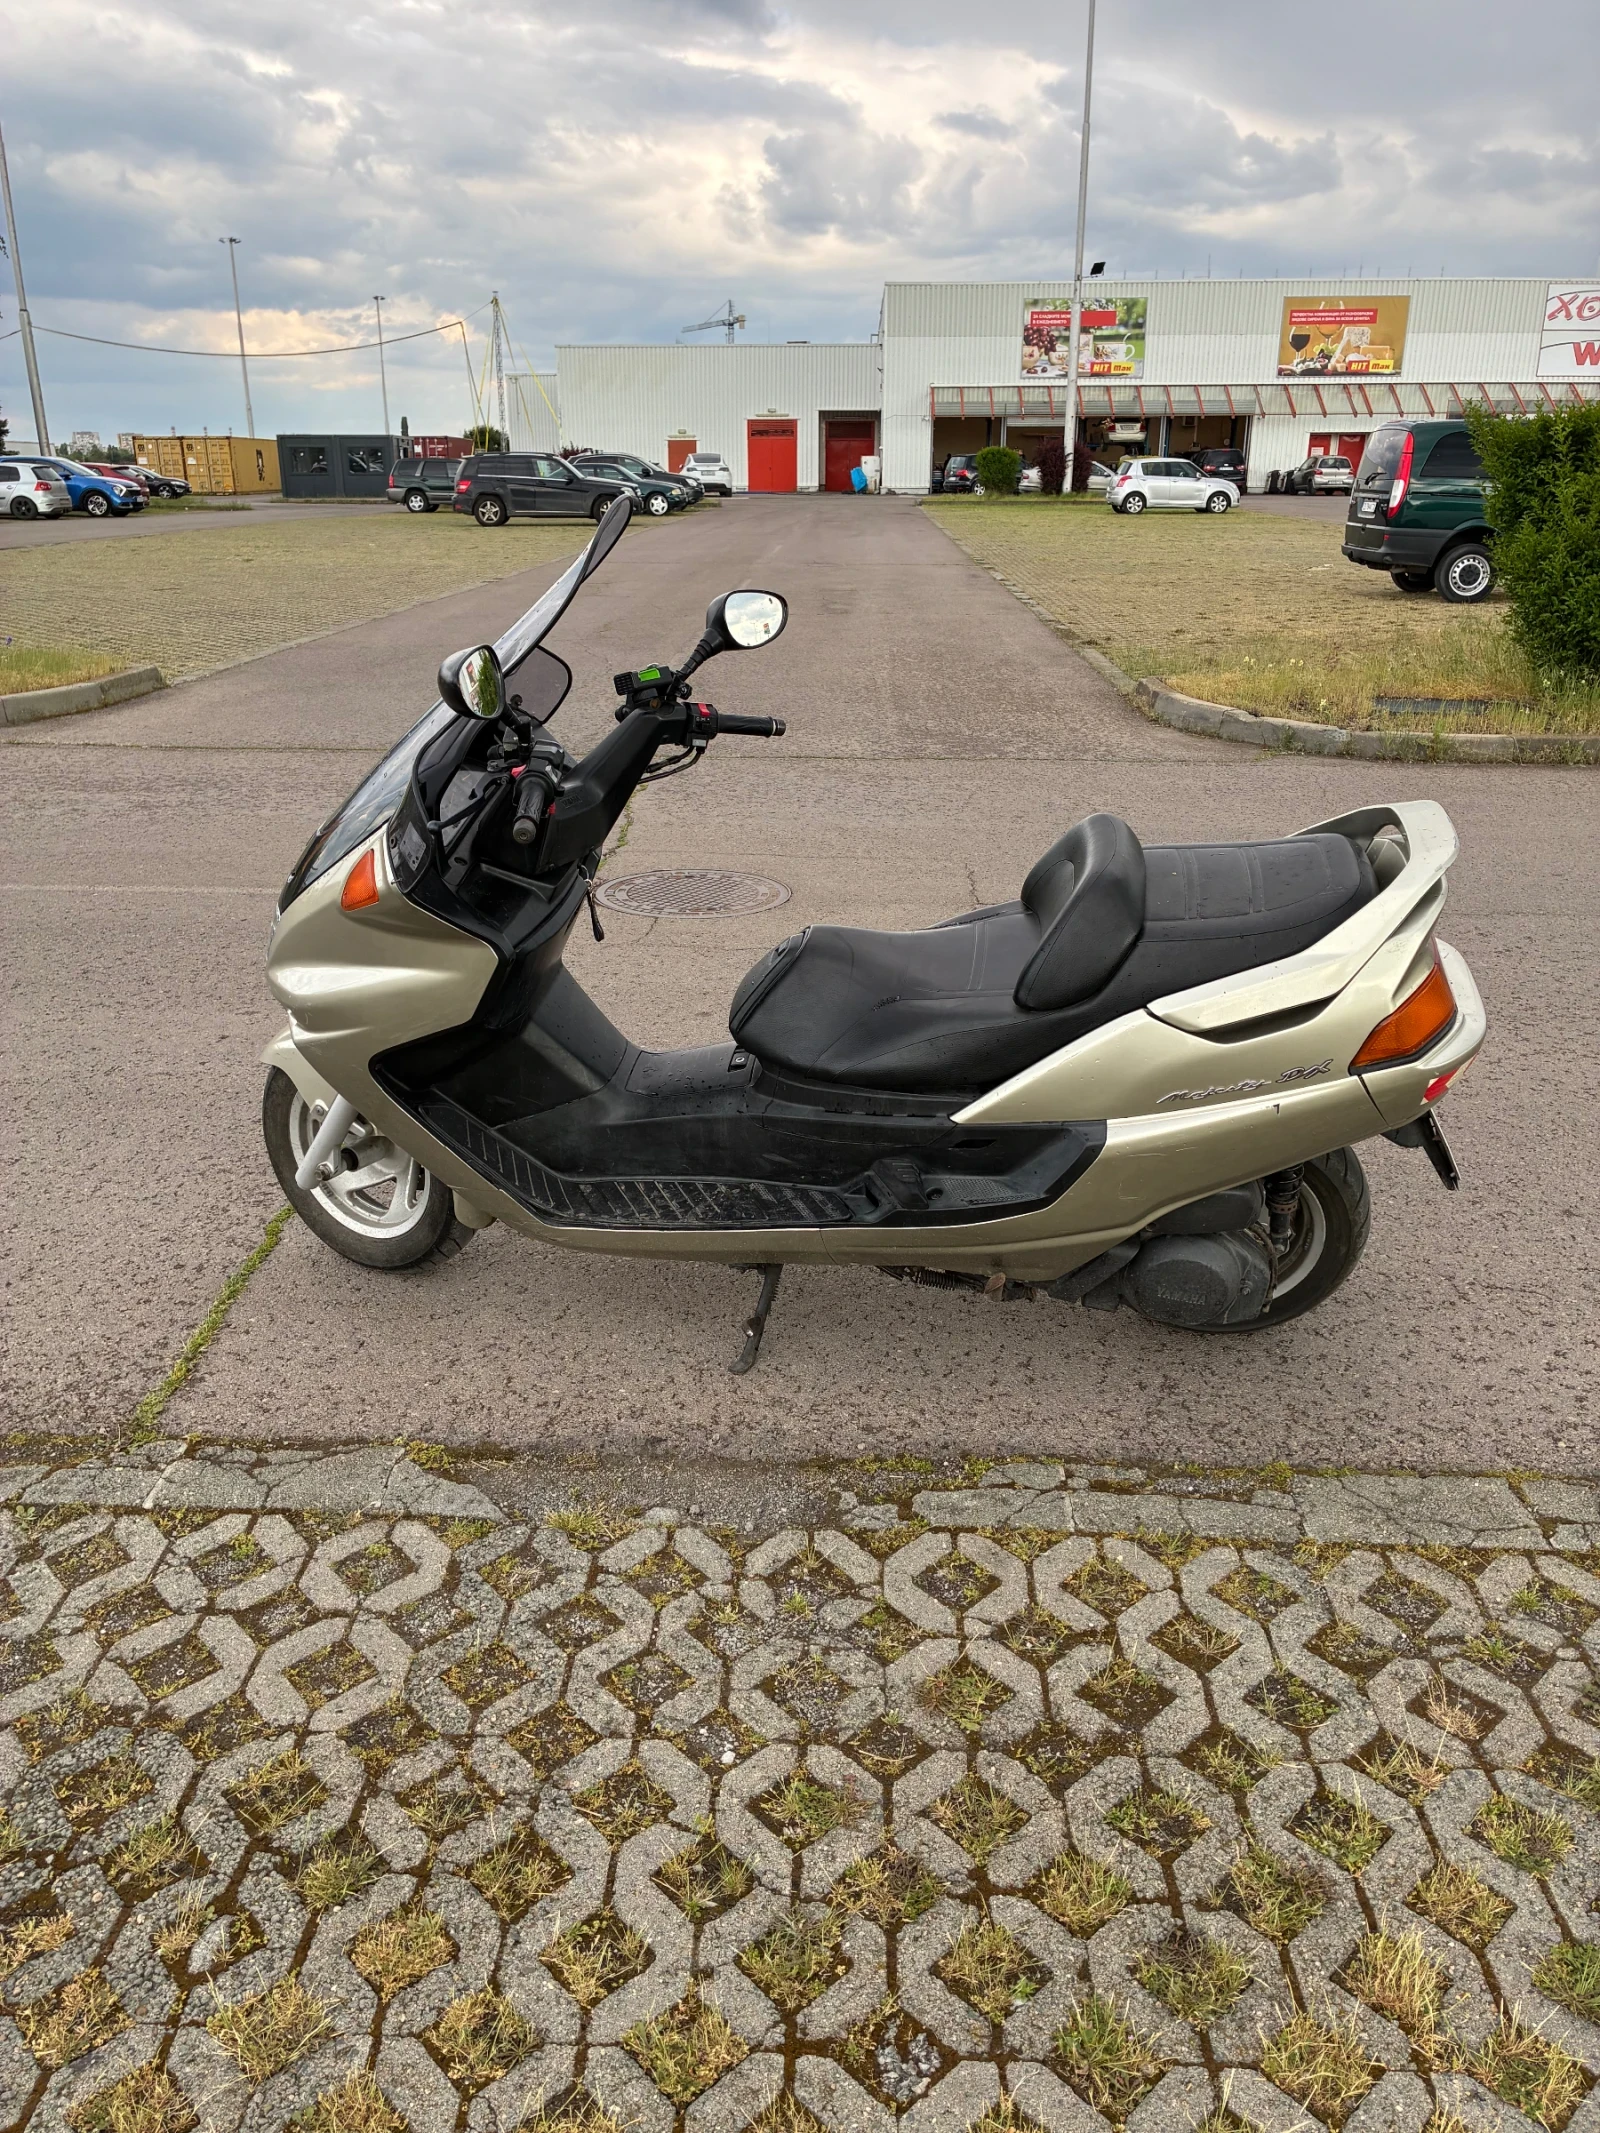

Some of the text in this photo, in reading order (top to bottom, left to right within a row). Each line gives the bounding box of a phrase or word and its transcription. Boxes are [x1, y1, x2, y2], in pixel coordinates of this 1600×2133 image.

[1093, 363, 1110, 372] HIT
[1351, 362, 1369, 370] HIT
[1276, 1058, 1334, 1083] DX
